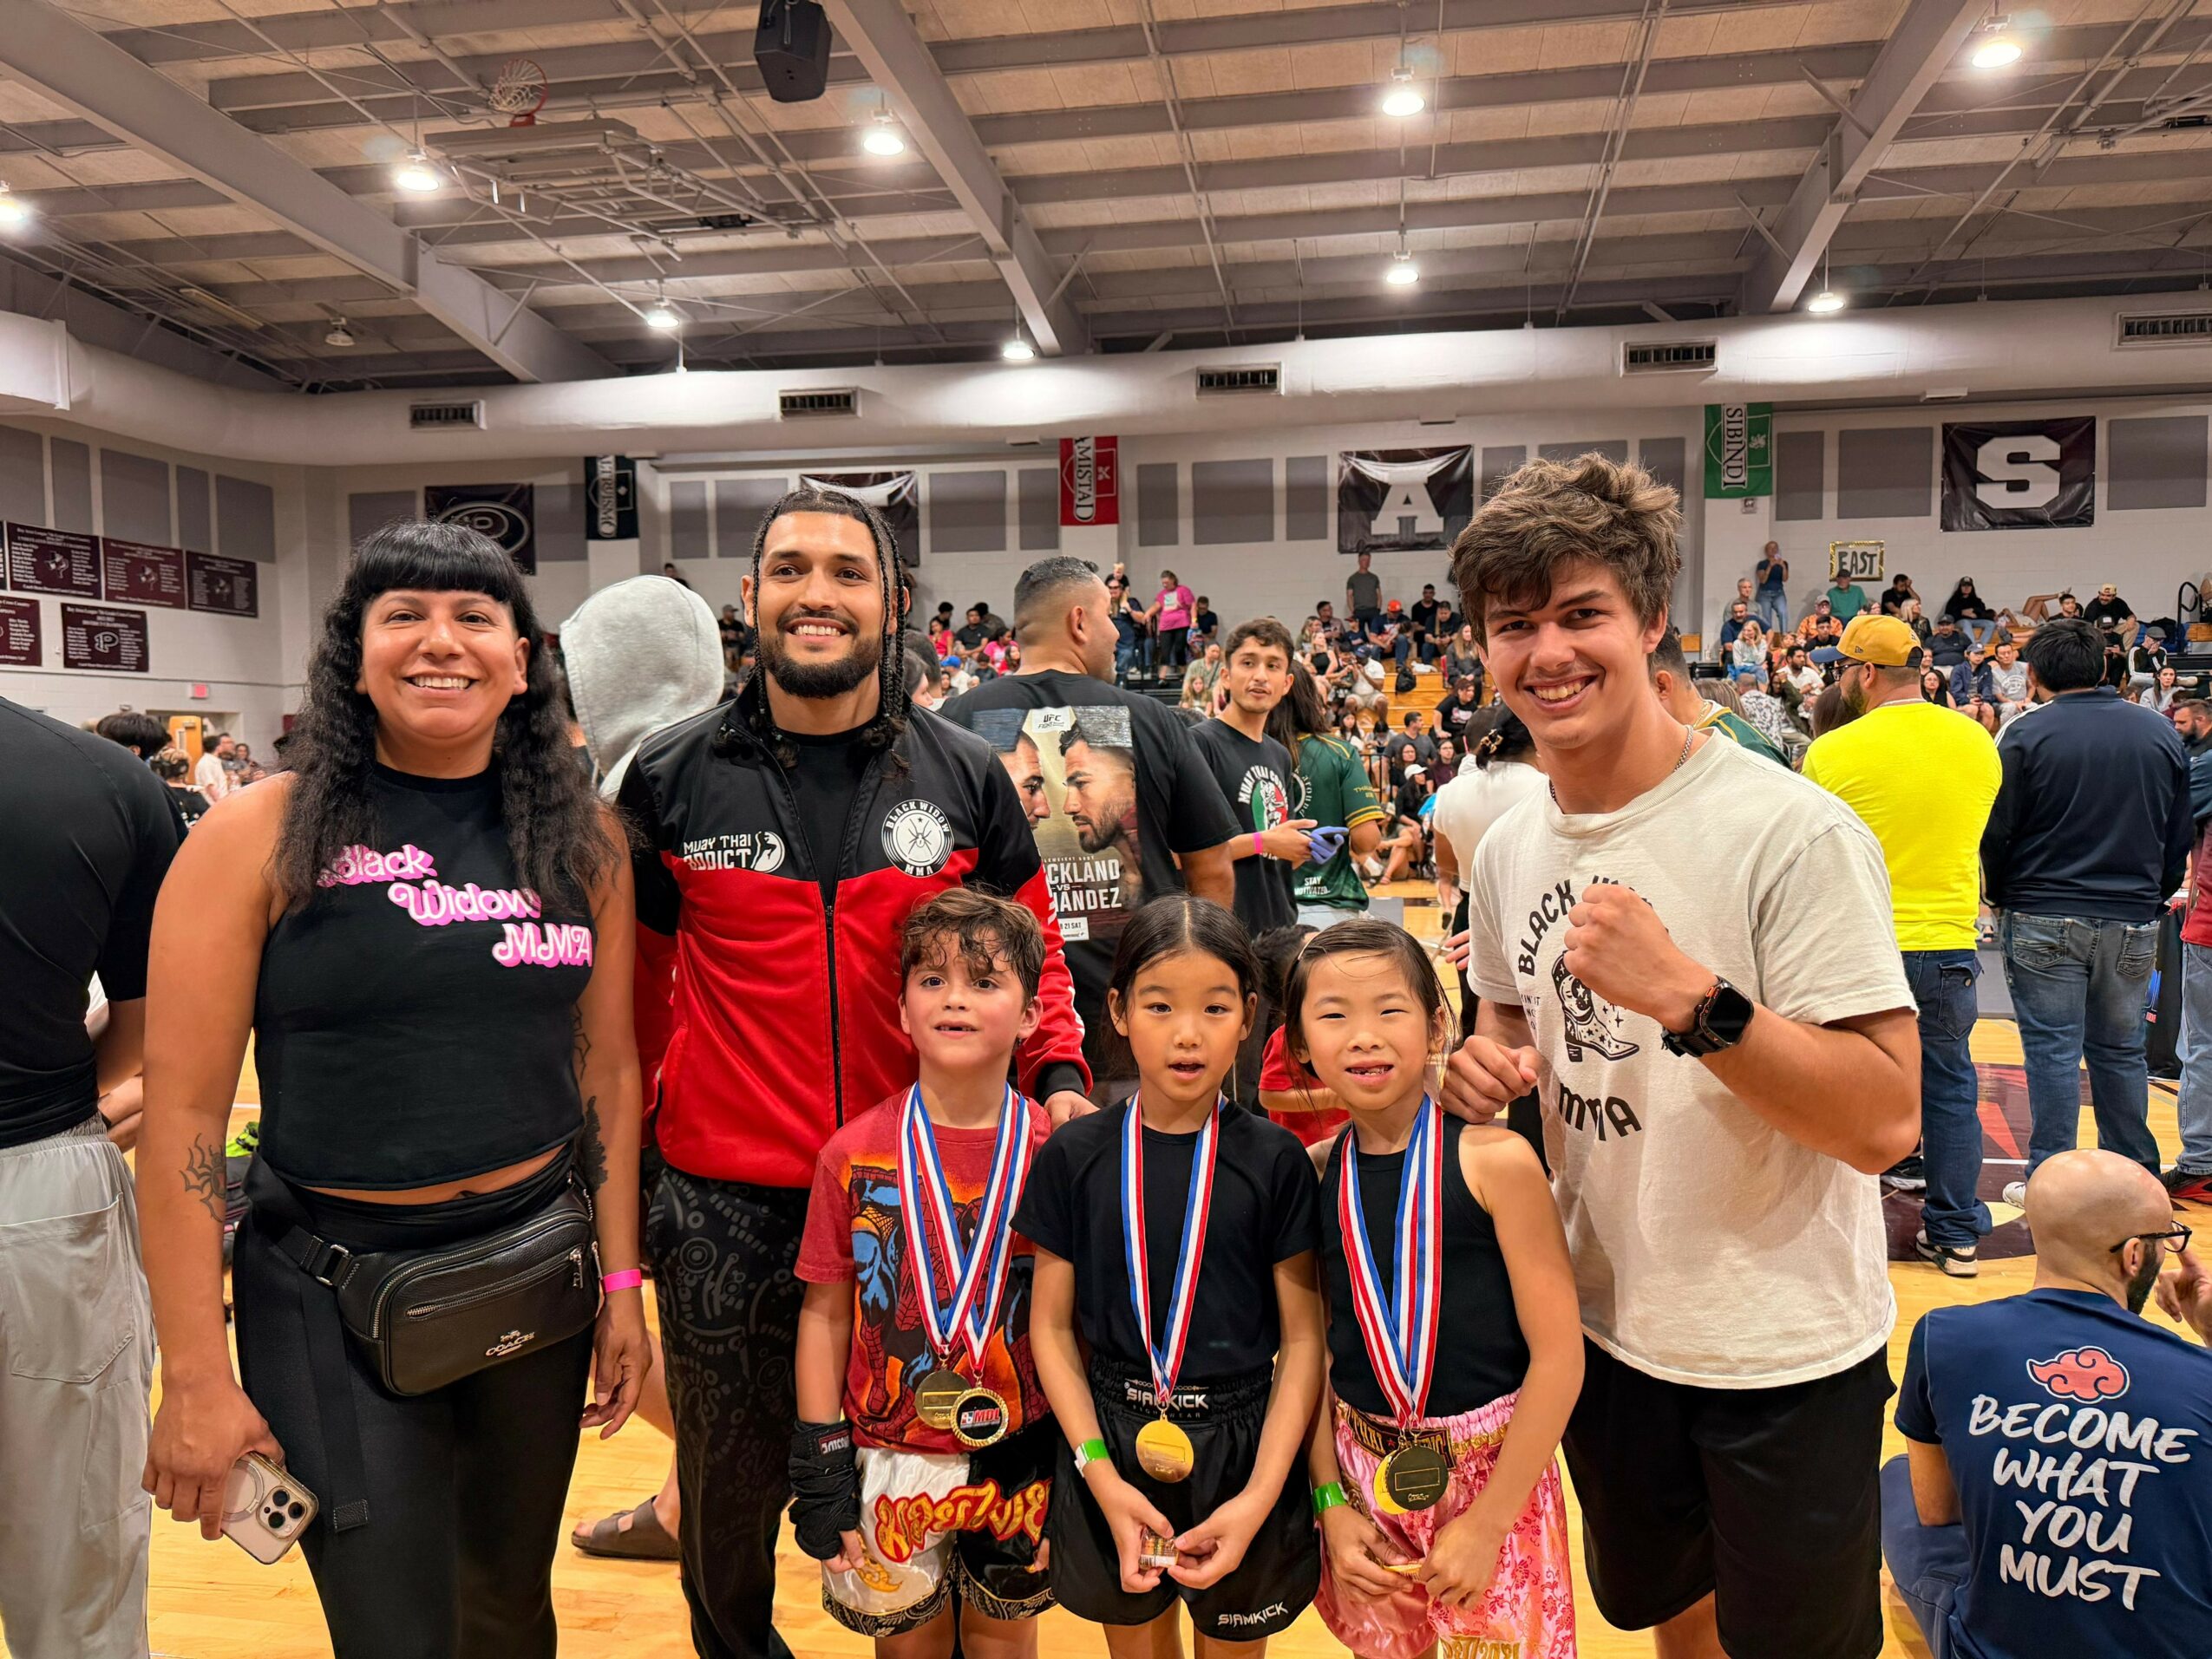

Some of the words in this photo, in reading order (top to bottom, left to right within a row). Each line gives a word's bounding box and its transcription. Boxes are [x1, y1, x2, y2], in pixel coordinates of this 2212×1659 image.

[1976, 435, 2061, 509] S
[1371, 468, 1444, 536] A
[1838, 550, 1877, 576] EAST
[1238, 770, 1256, 805] MUAY
[1250, 765, 1269, 779] THAI
[886, 801, 917, 829] BLACK
[919, 802, 950, 833] WIDOW
[317, 838, 437, 888] Black
[905, 864, 933, 876] MMA
[1047, 859, 1120, 885] CKLAND
[1305, 876, 1322, 886] STAY
[388, 879, 542, 926] Widow
[1052, 886, 1122, 912] ANDEZ
[492, 922, 592, 968] MMA
[1518, 878, 1577, 976] BLACK
[486, 1332, 535, 1356] COACH
[1968, 1394, 2200, 1464] BECOME
[1993, 1447, 2161, 1508] WHAT
[2015, 1499, 2133, 1554] YOU
[1999, 1544, 2162, 1611] MUST
[1217, 1601, 1289, 1628] SIAMKICK
